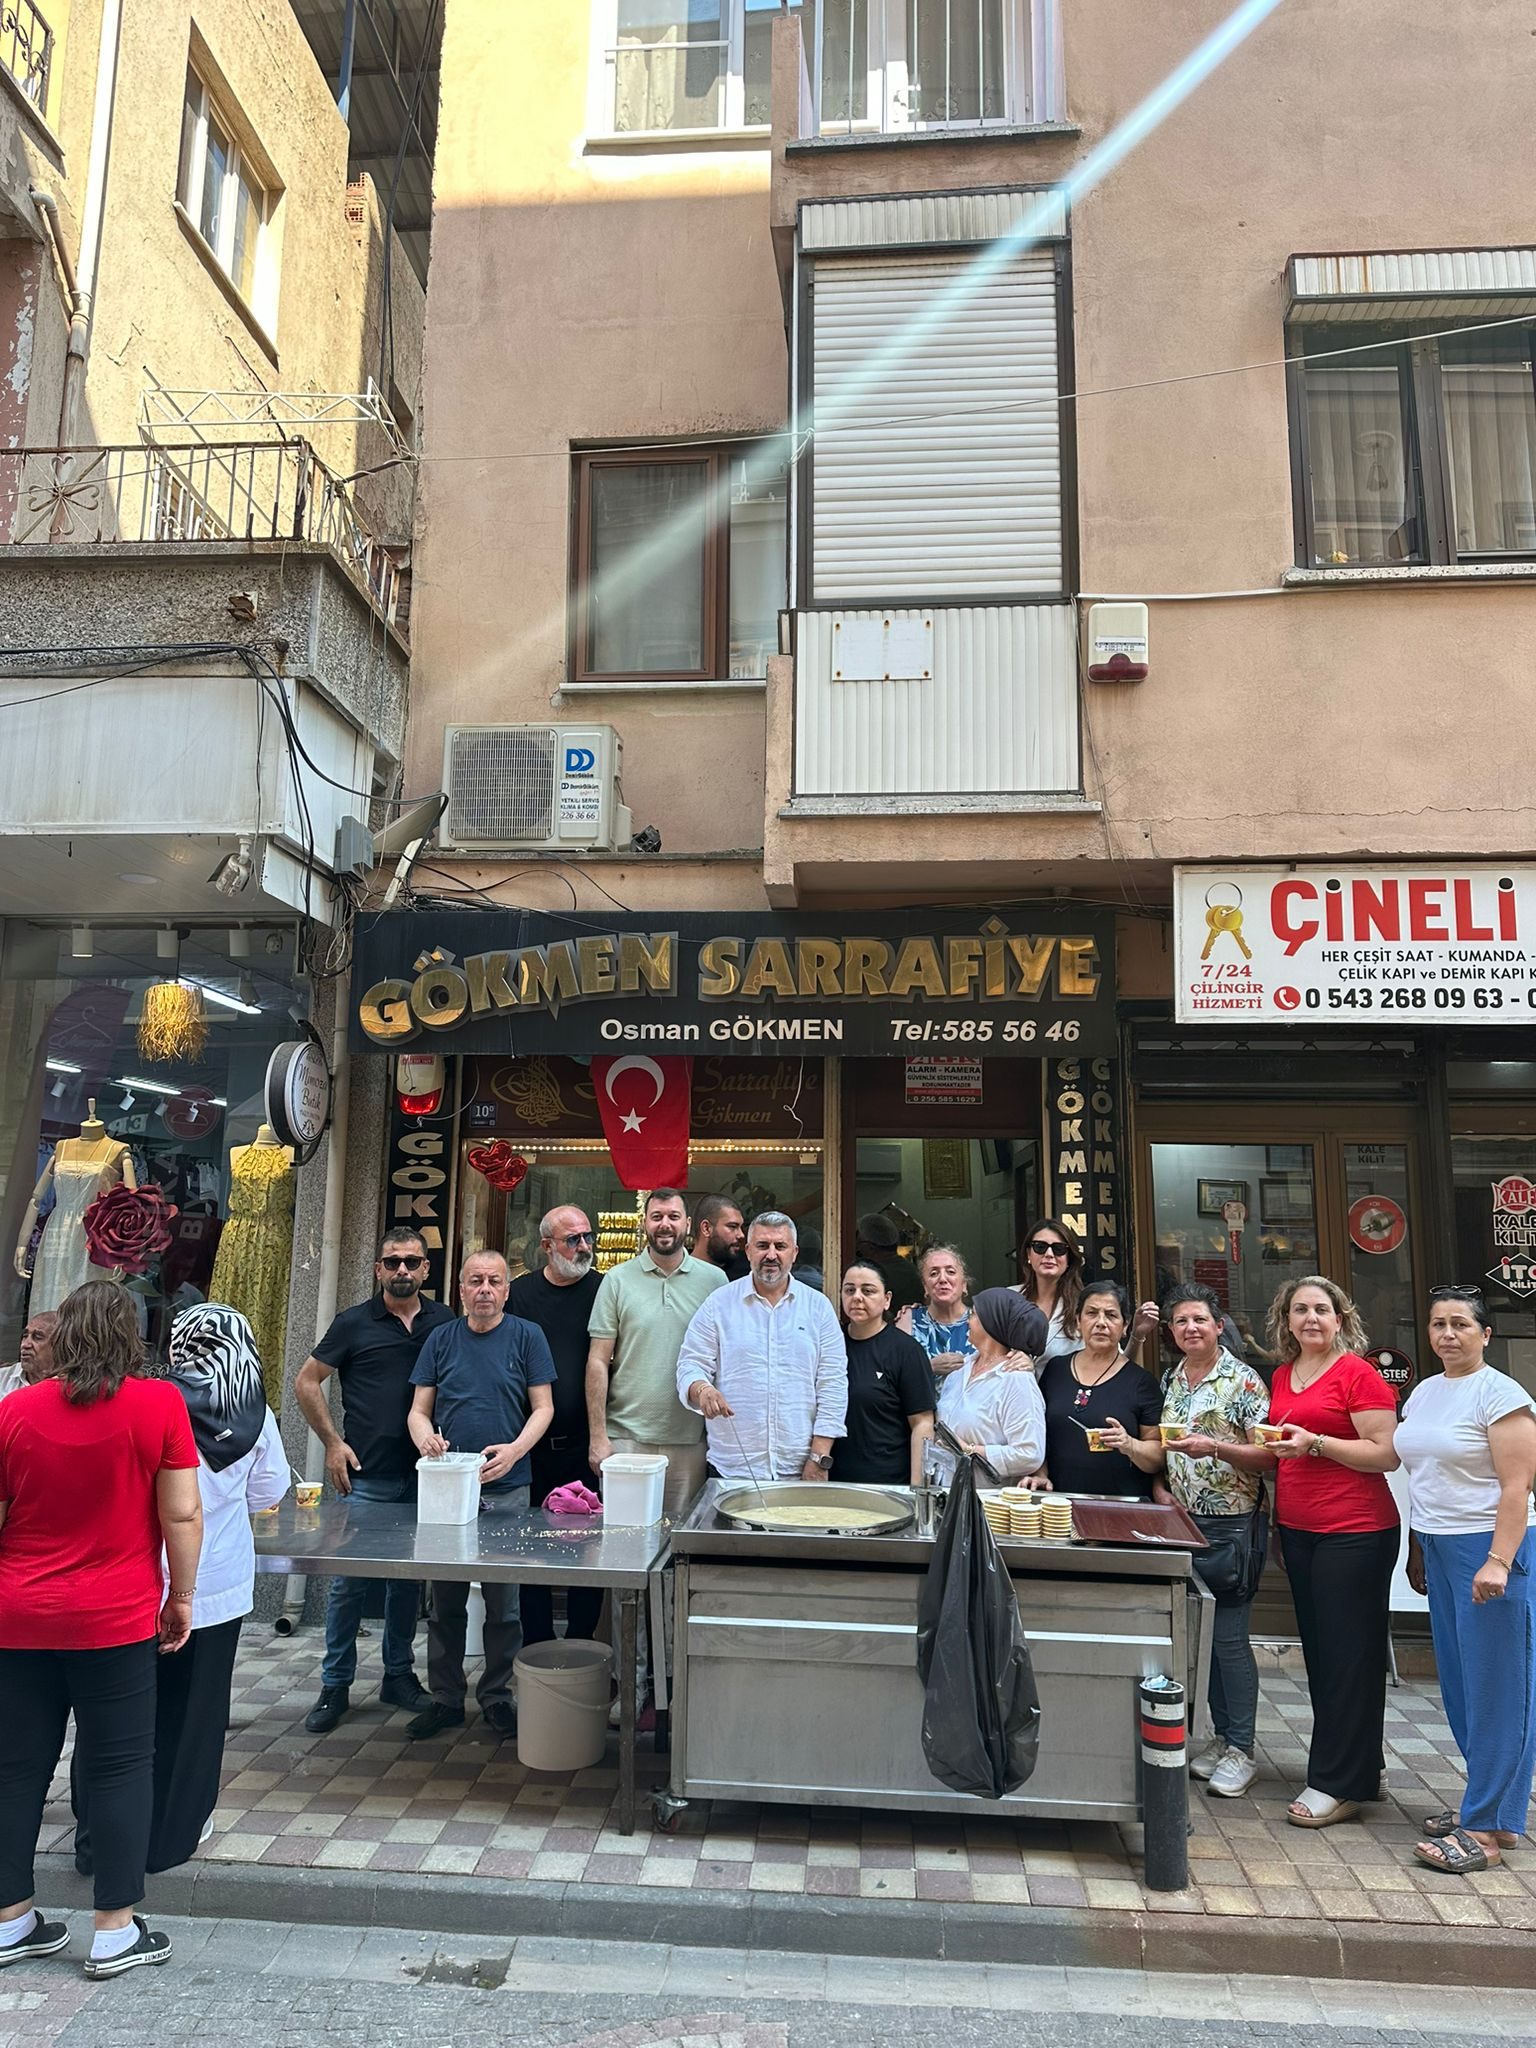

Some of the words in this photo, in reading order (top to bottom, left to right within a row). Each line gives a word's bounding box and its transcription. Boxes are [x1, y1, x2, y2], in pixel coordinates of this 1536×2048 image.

[1321, 950, 1349, 962] HER
[1353, 947, 1392, 965] ÇEŞİT
[1396, 950, 1434, 962] SAAT
[1448, 950, 1527, 962] KUMANDA
[359, 934, 675, 1041] GÖKMEN
[699, 915, 1100, 997] SARRAFİYE
[1200, 963, 1253, 980] 7/24
[1338, 965, 1378, 982] ÇELİK
[1382, 968, 1416, 979] KAPI
[1420, 970, 1437, 979] ve
[1441, 965, 1486, 979] DEMİR
[1491, 968, 1525, 979] KAPI
[1190, 981, 1265, 997] ÇİLİNGİR
[1192, 996, 1263, 1010] HİZMETİ
[1305, 988, 1320, 1008] 0
[1328, 988, 1373, 1008] 543
[1380, 988, 1426, 1008] 268
[1434, 988, 1466, 1008] 09
[1473, 988, 1503, 1008] 63
[600, 1018, 700, 1041] Osman
[709, 1014, 844, 1041] GÖKMEN
[890, 1020, 994, 1042] Tel:585
[1002, 1020, 1038, 1042] 56
[1044, 1020, 1081, 1042] 46
[1091, 1058, 1117, 1270] GÖKMENS
[1377, 1369, 1408, 1379] ASTER
